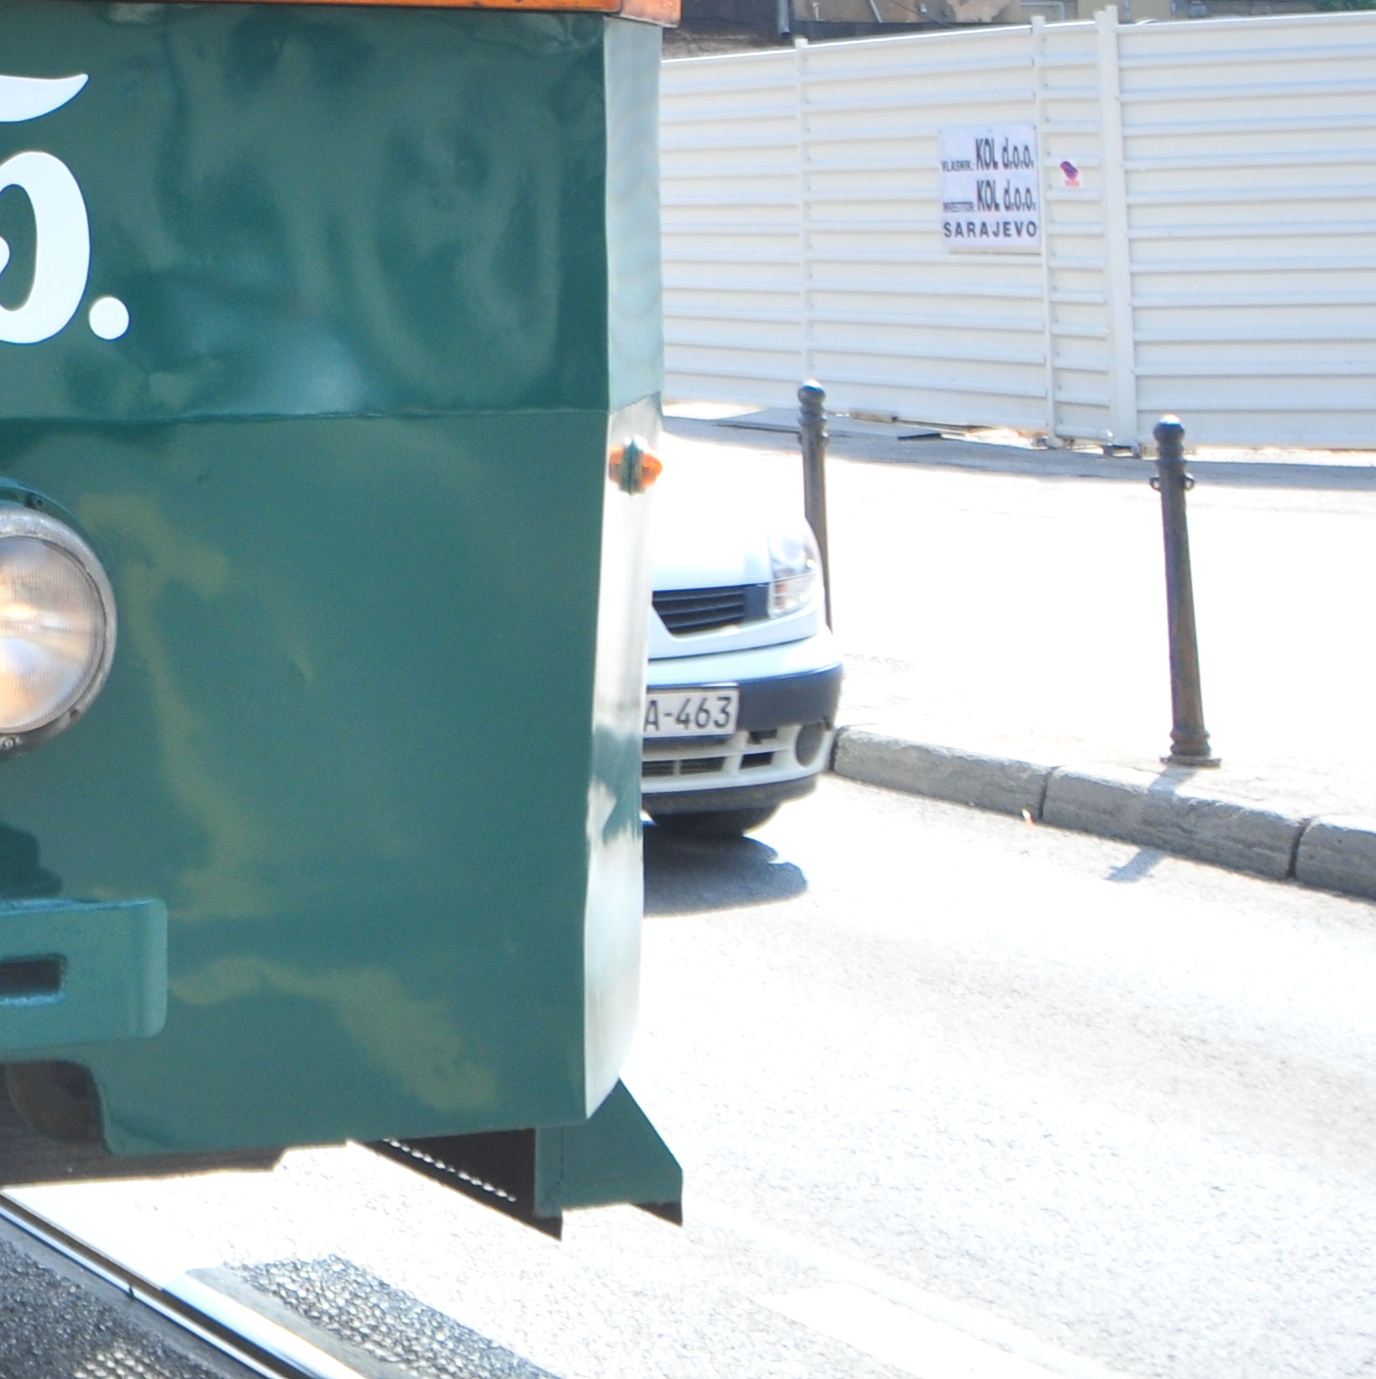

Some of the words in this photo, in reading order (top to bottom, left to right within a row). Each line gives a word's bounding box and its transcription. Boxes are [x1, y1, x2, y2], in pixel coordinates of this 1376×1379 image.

[975, 137, 999, 171] KOL
[1002, 137, 1035, 170] d.o.o.
[977, 179, 1001, 213] KOL
[1003, 179, 1037, 212] d.o.o.
[943, 220, 1038, 238] SARAJEVO
